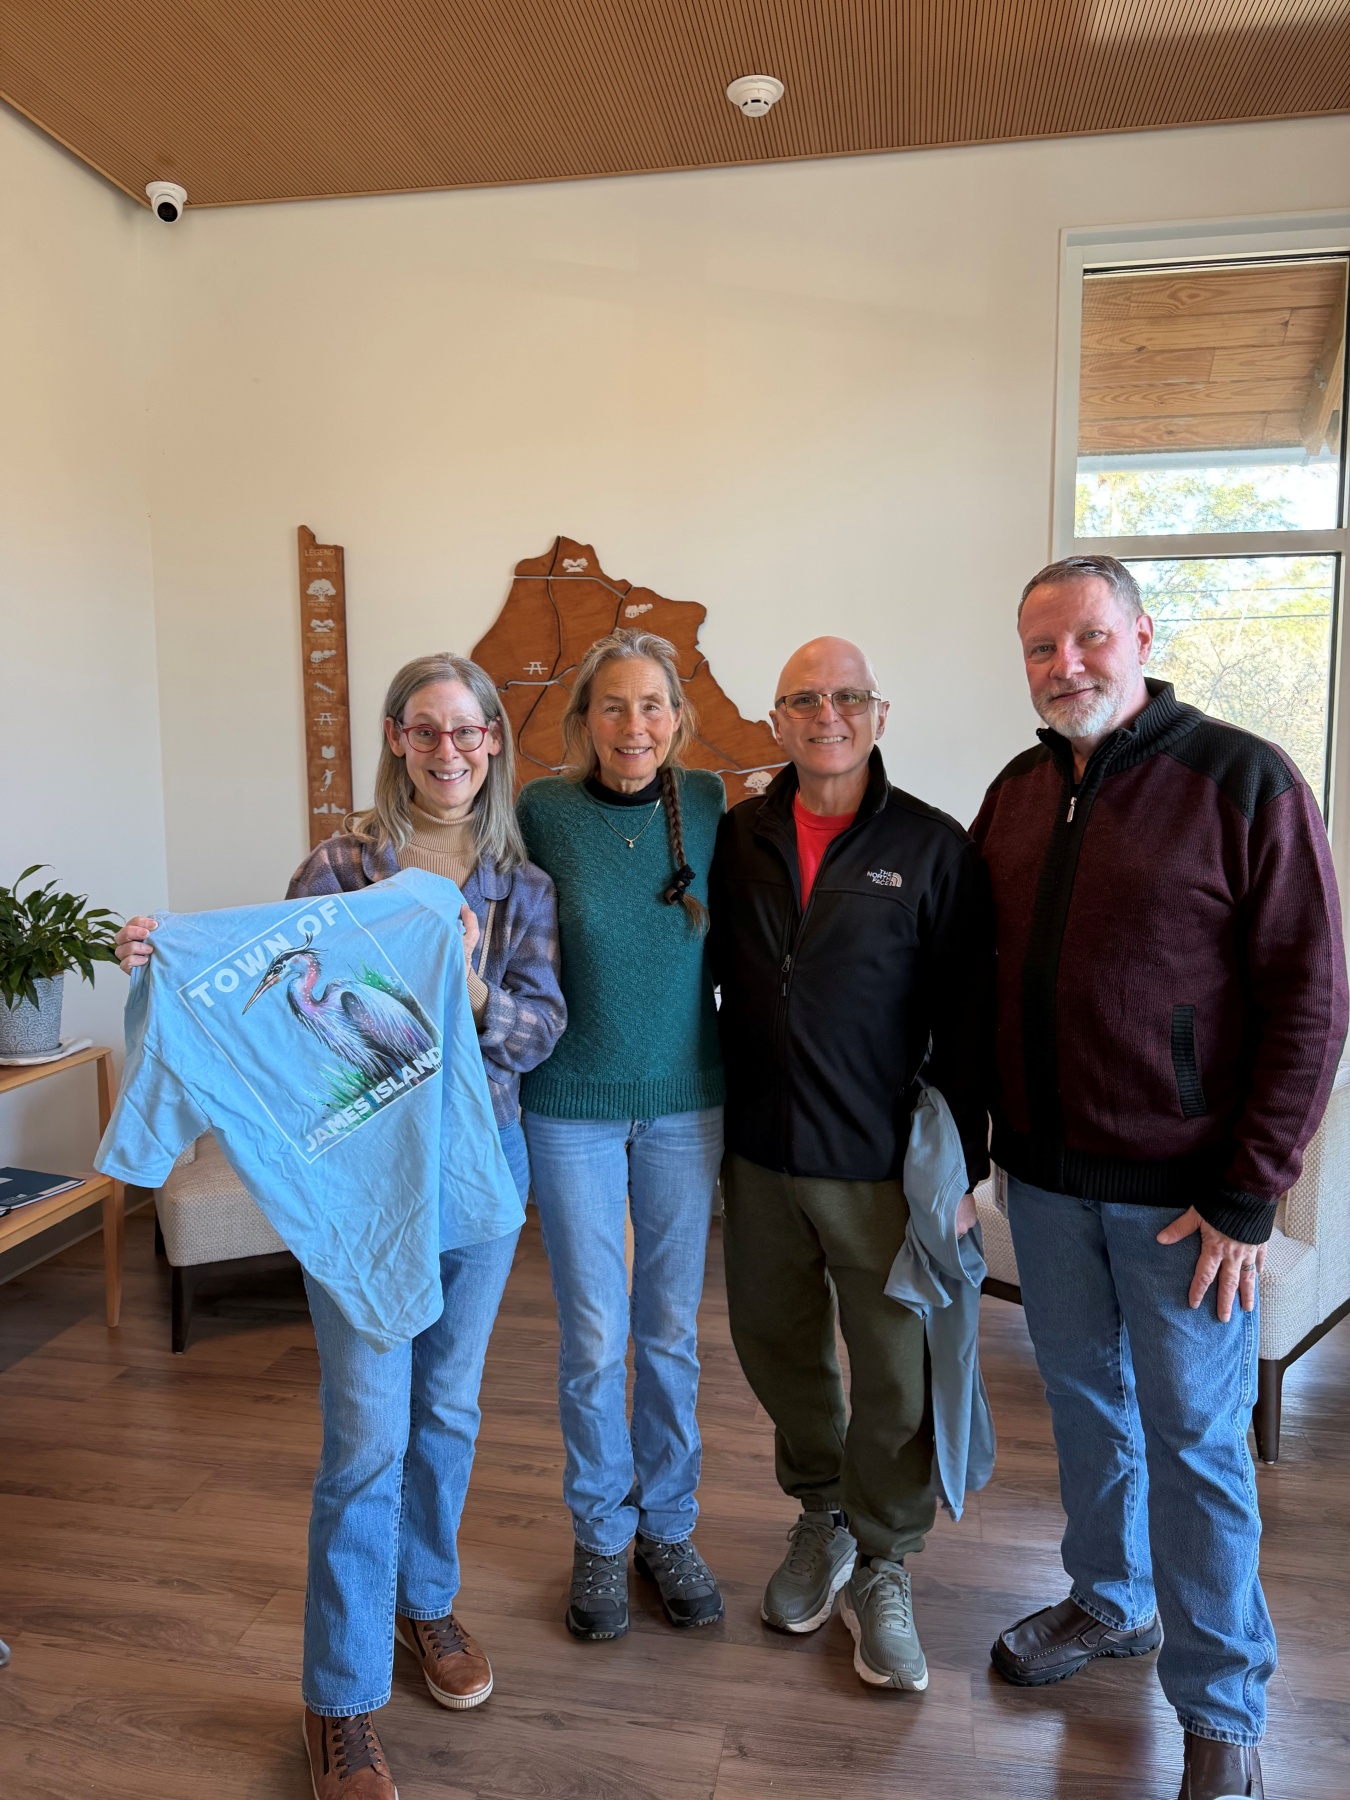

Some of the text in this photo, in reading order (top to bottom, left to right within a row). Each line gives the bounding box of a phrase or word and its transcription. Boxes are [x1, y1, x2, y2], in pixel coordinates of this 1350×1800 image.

[305, 548, 336, 557] LEGEND
[867, 871, 891, 880] NORTH
[872, 878, 889, 886] FACE
[188, 900, 339, 1008] TOWN OF
[306, 1046, 442, 1153] JAMES ISLAND
